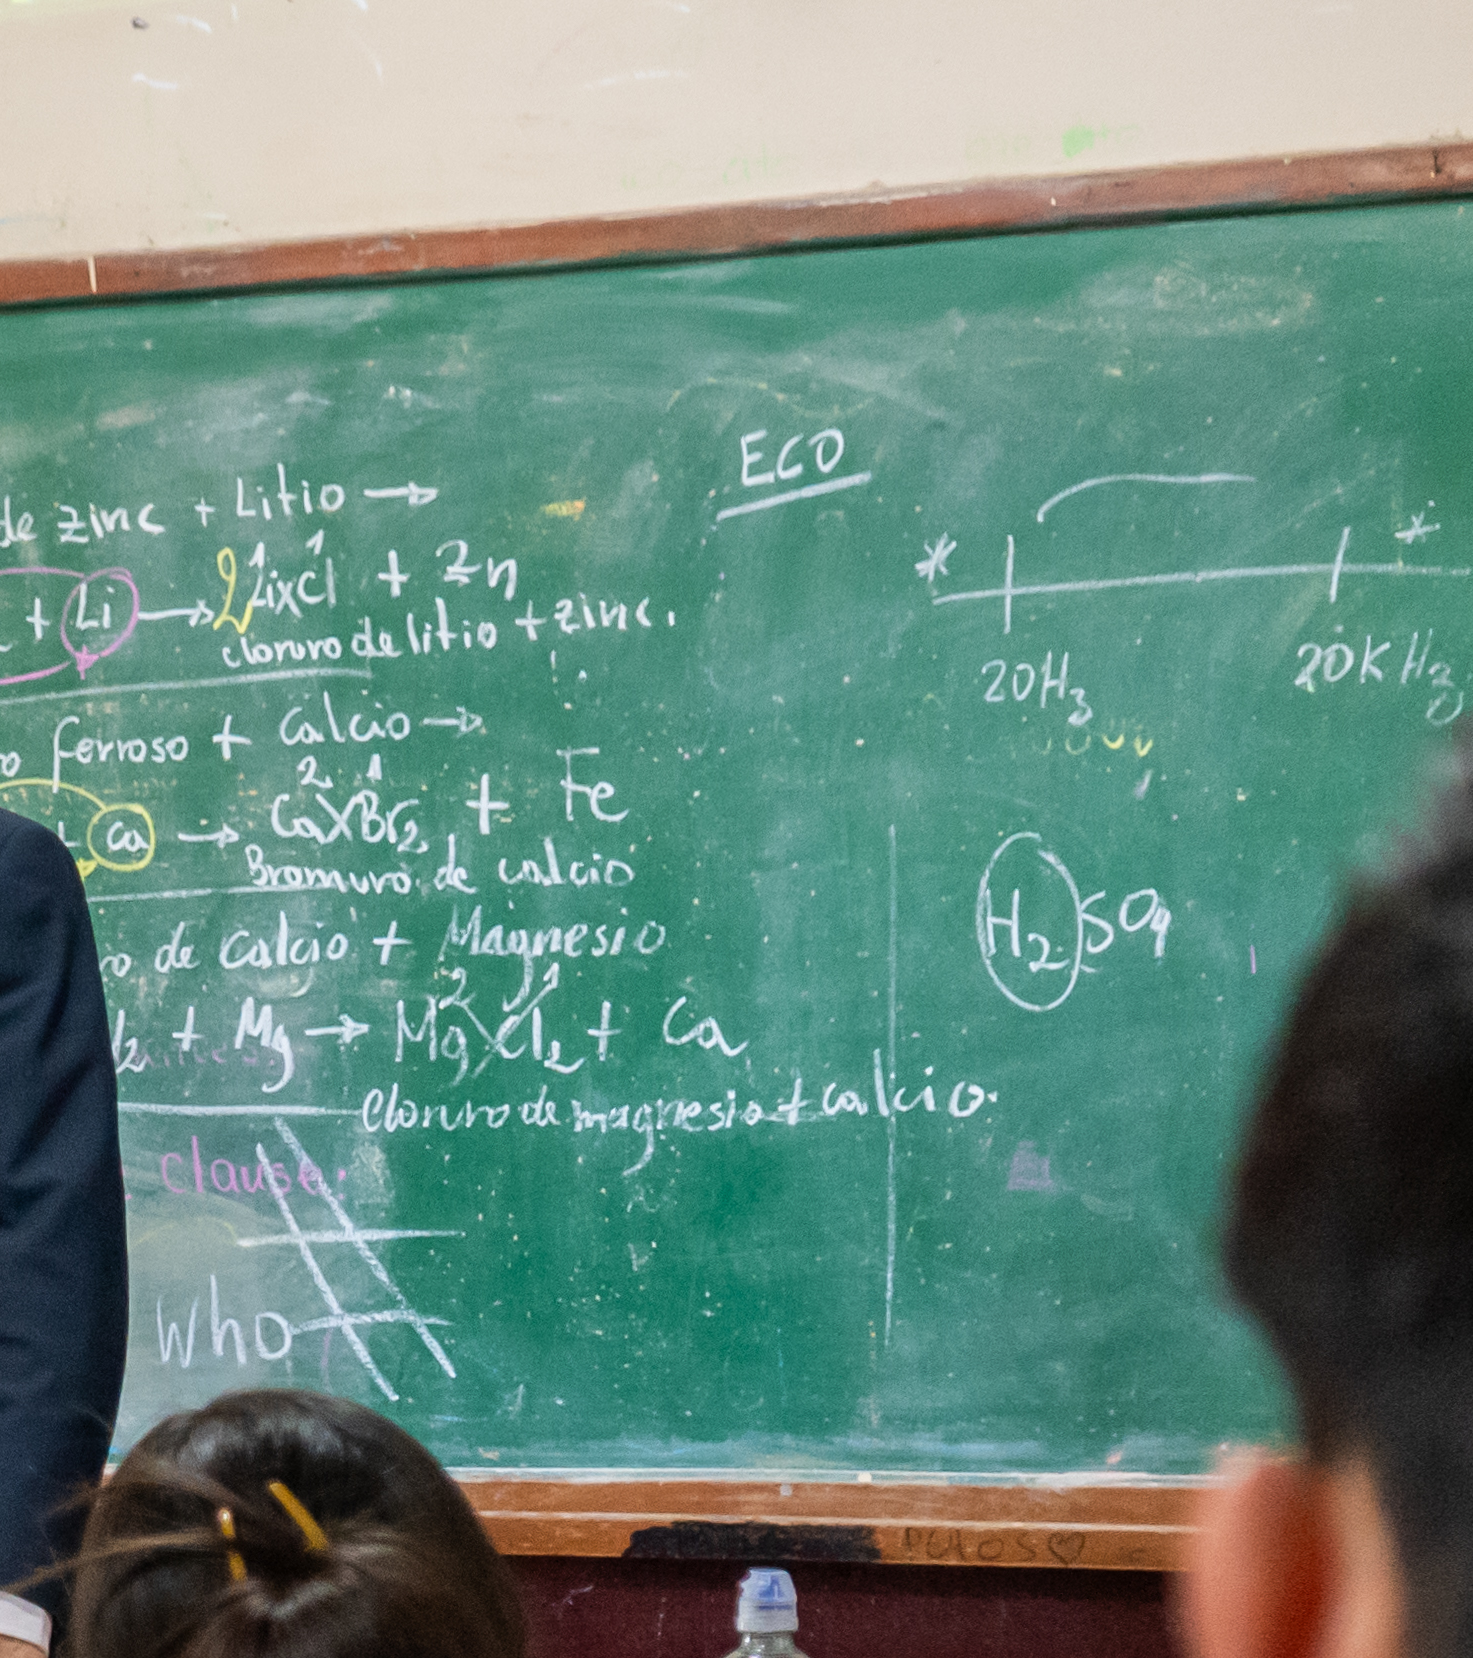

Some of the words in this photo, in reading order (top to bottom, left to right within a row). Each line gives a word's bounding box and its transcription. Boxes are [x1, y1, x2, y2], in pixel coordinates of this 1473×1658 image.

[739, 427, 847, 487] ECO
[353, 615, 402, 659] de
[555, 746, 630, 823] Fe
[435, 833, 478, 894] de
[154, 922, 200, 975] de
